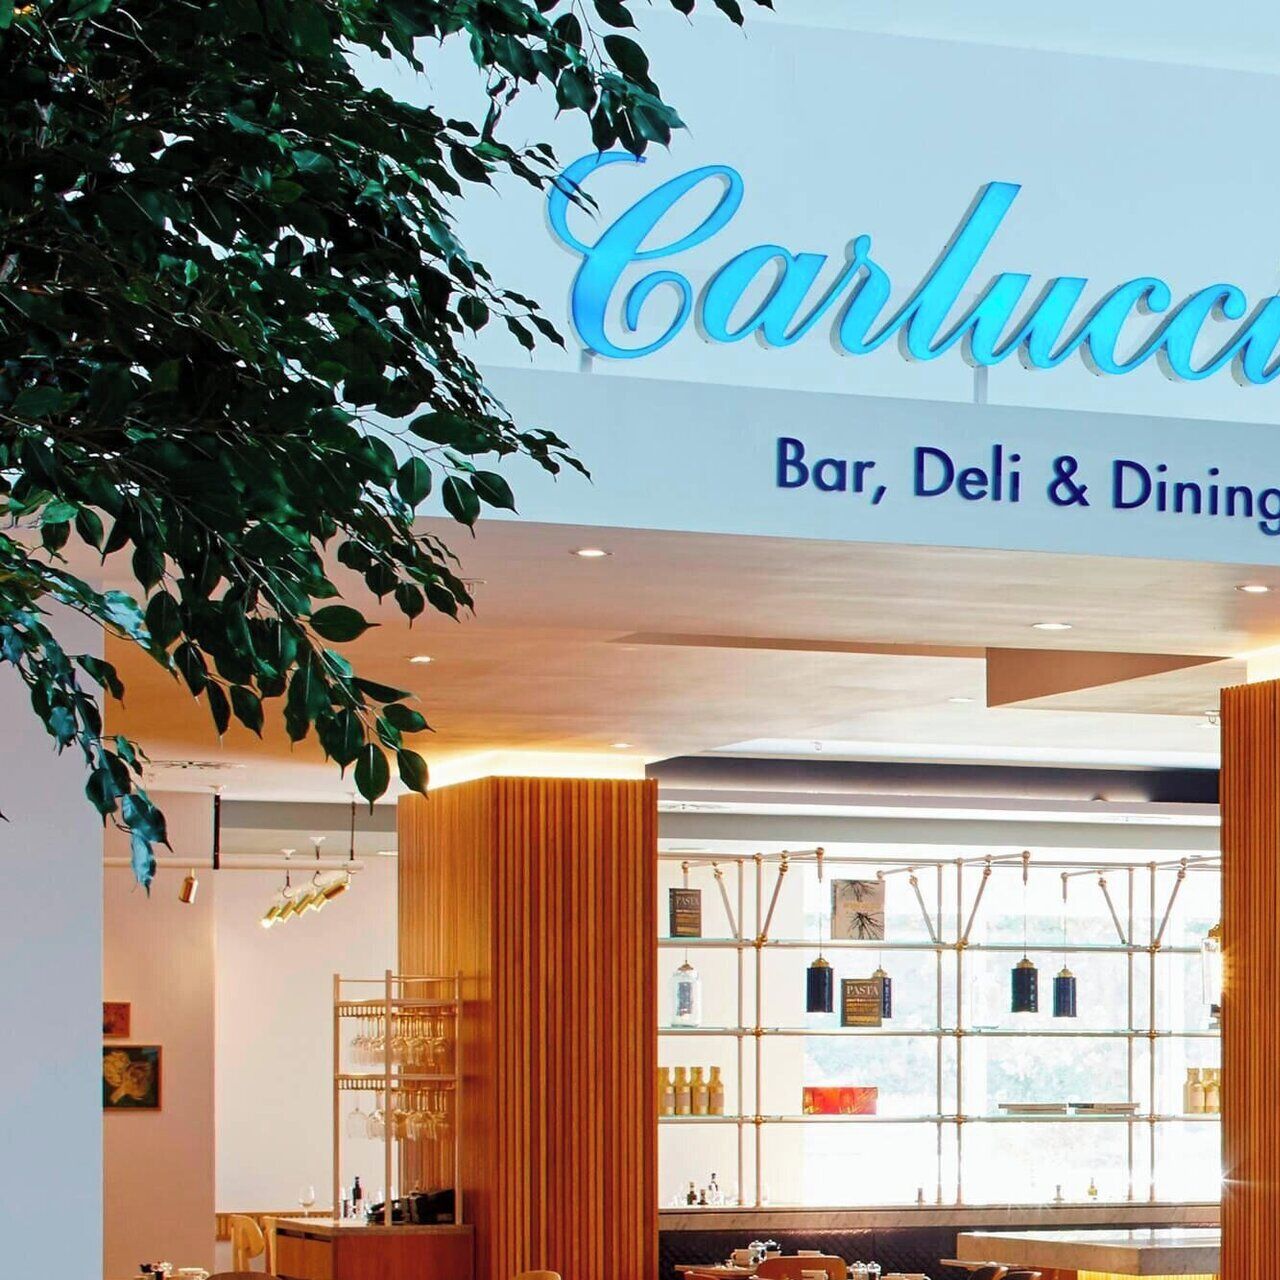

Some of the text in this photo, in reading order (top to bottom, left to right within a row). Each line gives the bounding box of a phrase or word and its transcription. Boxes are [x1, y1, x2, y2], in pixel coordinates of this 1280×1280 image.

[775, 436, 888, 505] Bar,
[913, 443, 1022, 503] Deli
[1046, 454, 1091, 508] &
[846, 985, 879, 996] PASTA
